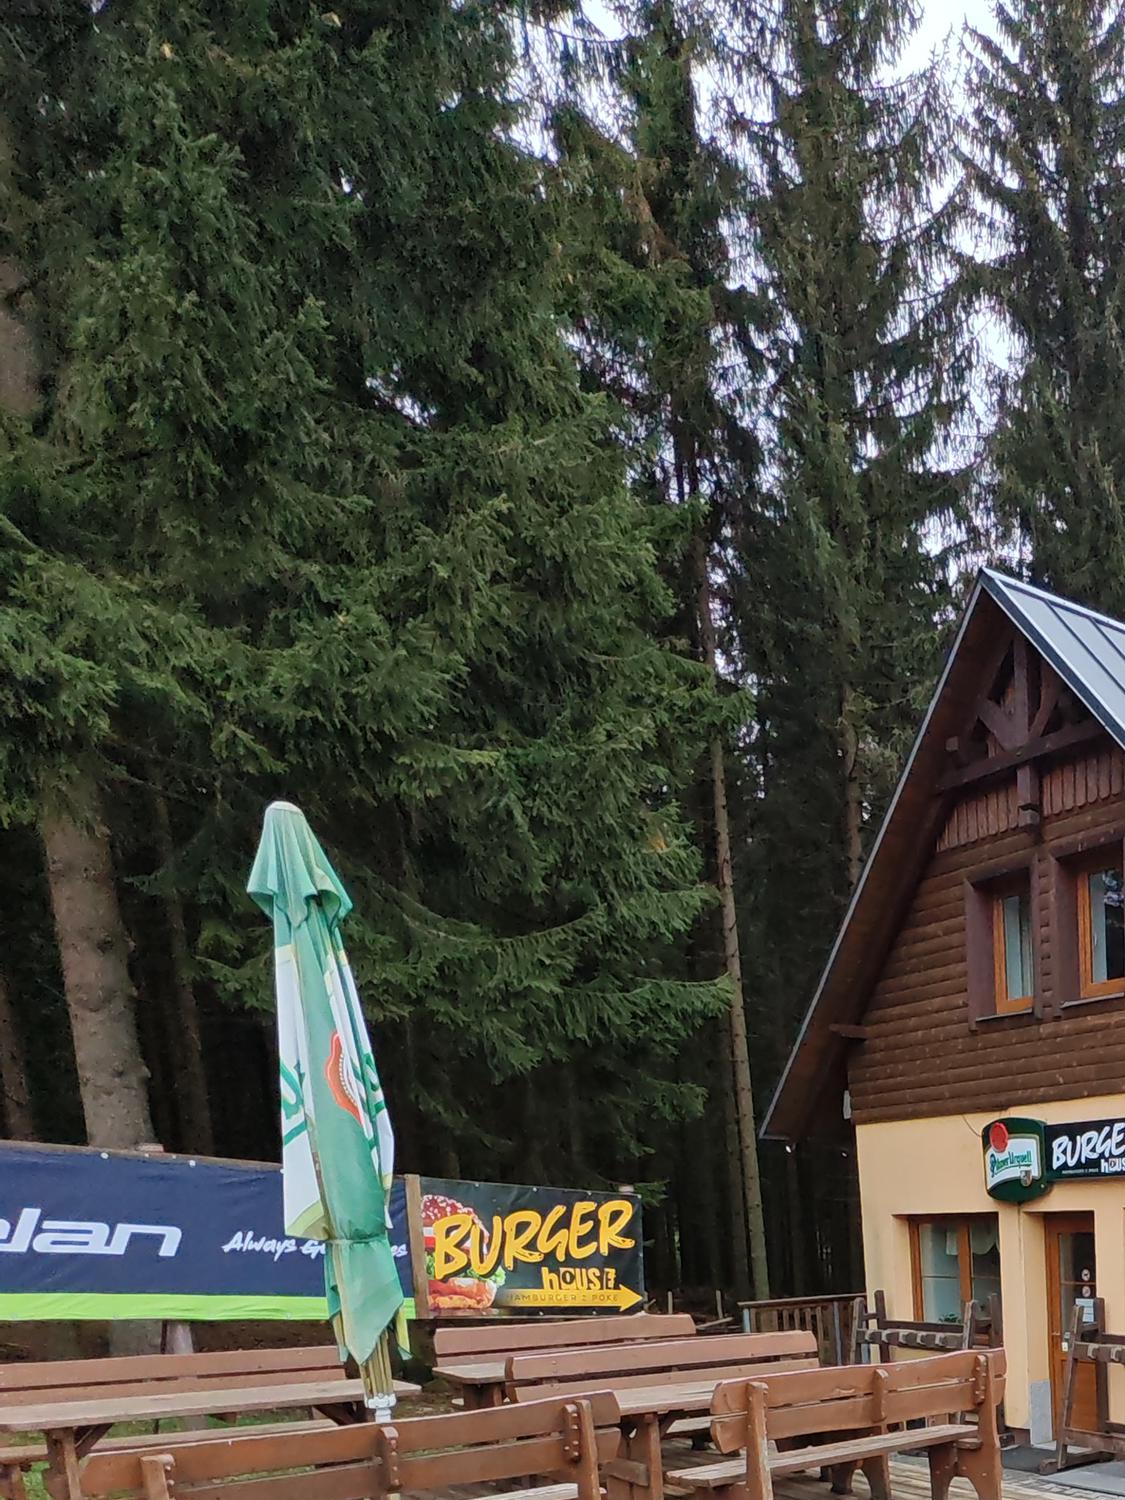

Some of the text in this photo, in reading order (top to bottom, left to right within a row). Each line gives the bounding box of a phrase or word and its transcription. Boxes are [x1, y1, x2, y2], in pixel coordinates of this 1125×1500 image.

[1008, 1150, 1032, 1169] Urquell
[222, 1231, 298, 1262] Always
[432, 1199, 636, 1280] BURGER
[506, 1292, 577, 1302] HAMBURGER
